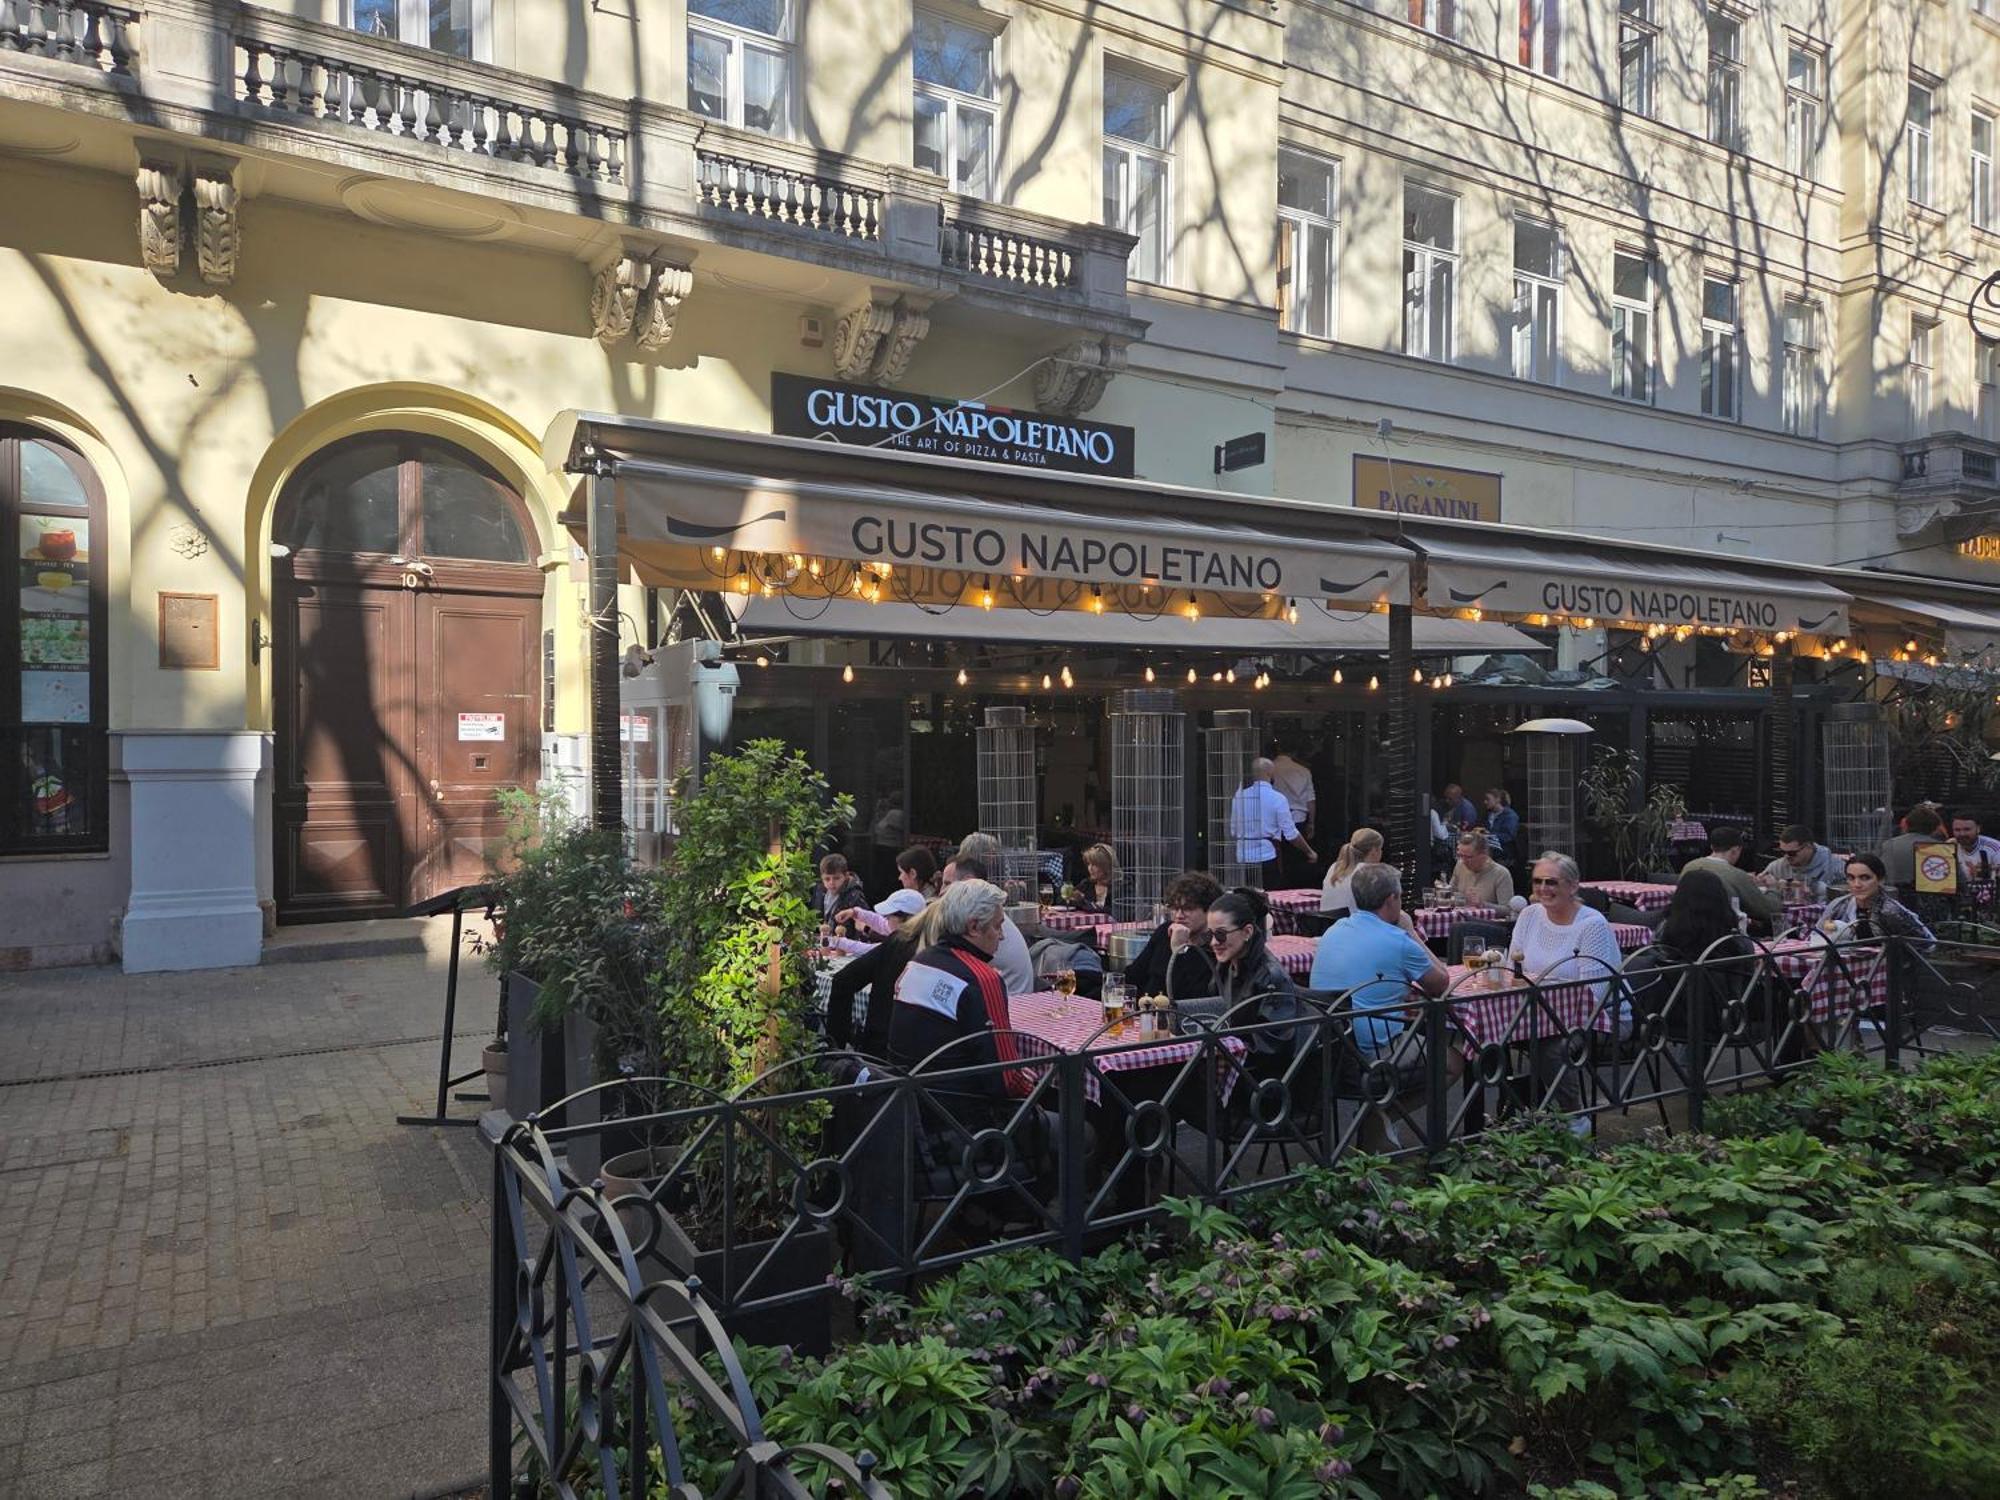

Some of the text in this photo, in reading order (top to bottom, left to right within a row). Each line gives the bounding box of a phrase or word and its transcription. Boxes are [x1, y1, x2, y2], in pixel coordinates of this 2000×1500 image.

[808, 389, 1115, 464] GUSTO NAPOLETANO
[890, 433, 1047, 465] THE ART OF PIZZA & PASTA
[1378, 489, 1481, 522] PAGANINI
[852, 516, 1282, 591] GUSTO NAPOLETANO
[400, 573, 417, 588] 10
[1543, 582, 1777, 627] GUSTO NAPOLETANO
